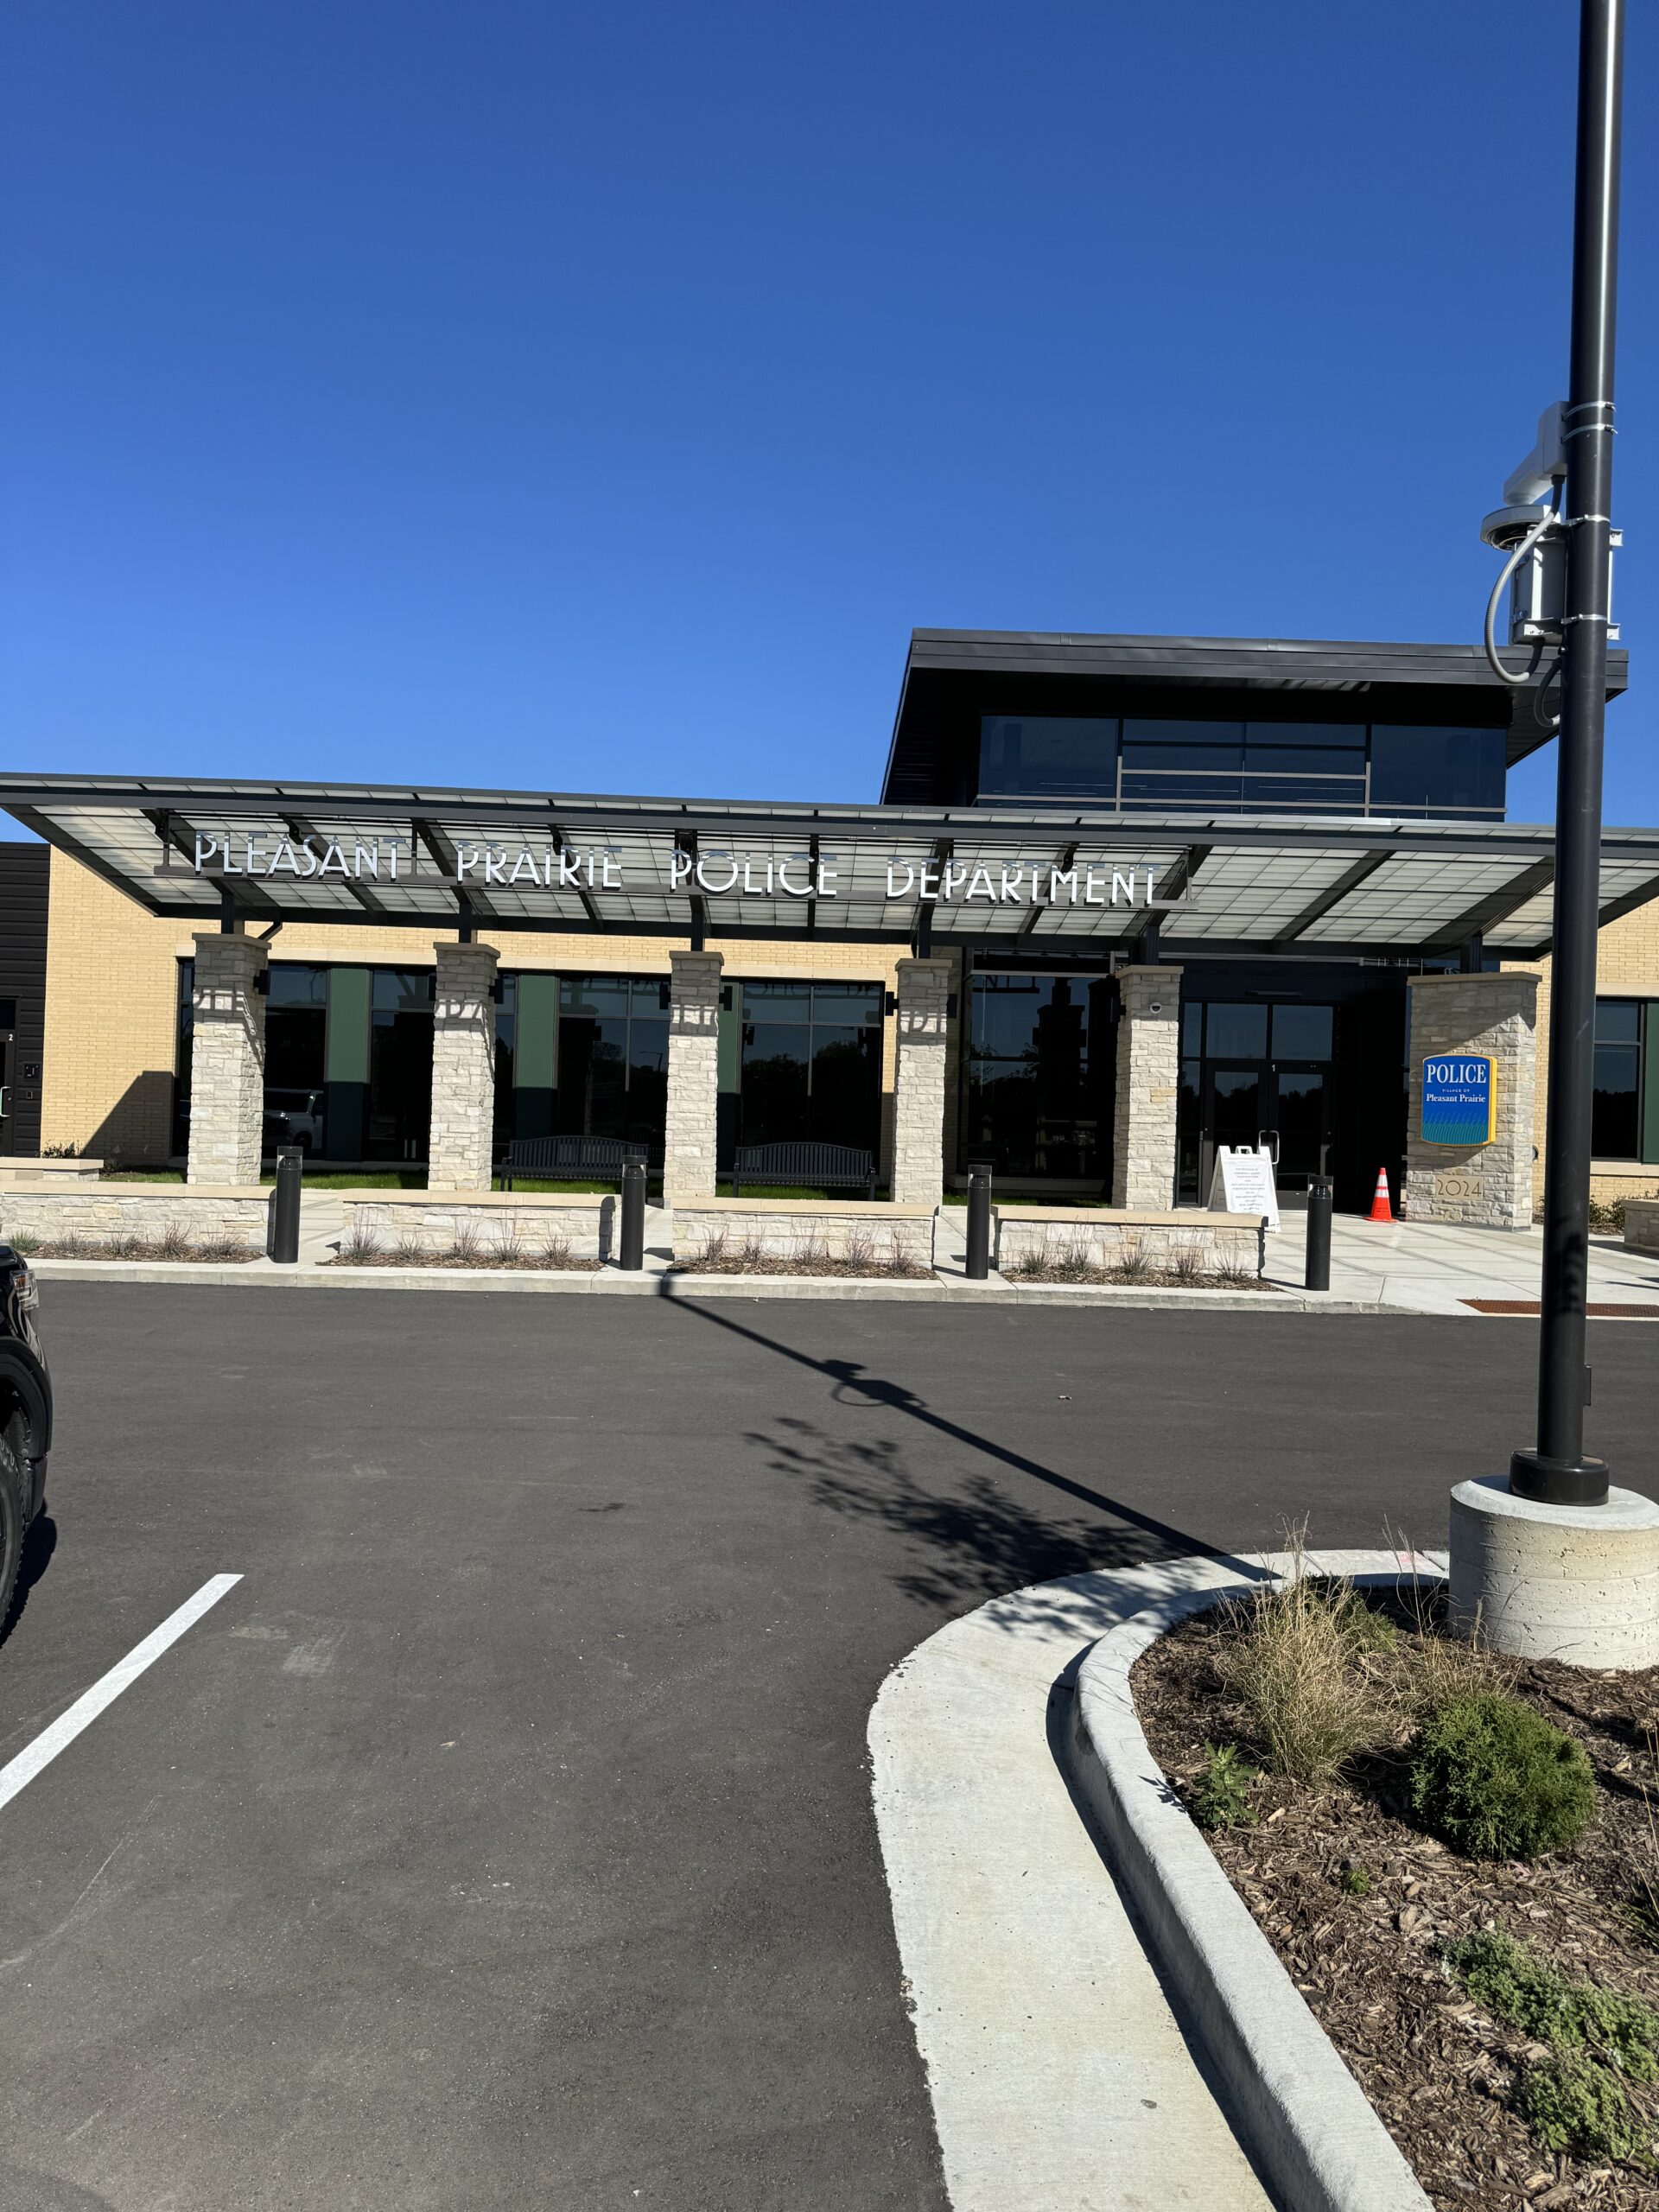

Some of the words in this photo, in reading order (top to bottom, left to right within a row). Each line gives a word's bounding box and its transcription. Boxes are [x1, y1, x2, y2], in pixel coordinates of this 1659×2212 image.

[195, 830, 405, 879] PLEASANT
[458, 840, 623, 889] PRAIRIE
[671, 849, 838, 897] POLICE
[887, 855, 1160, 906] DEPARTMENT
[1426, 1064, 1486, 1084] POLICE
[1426, 1093, 1458, 1103] Pleasant
[1459, 1094, 1486, 1103] Prairie
[1437, 1179, 1482, 1198] 2024
